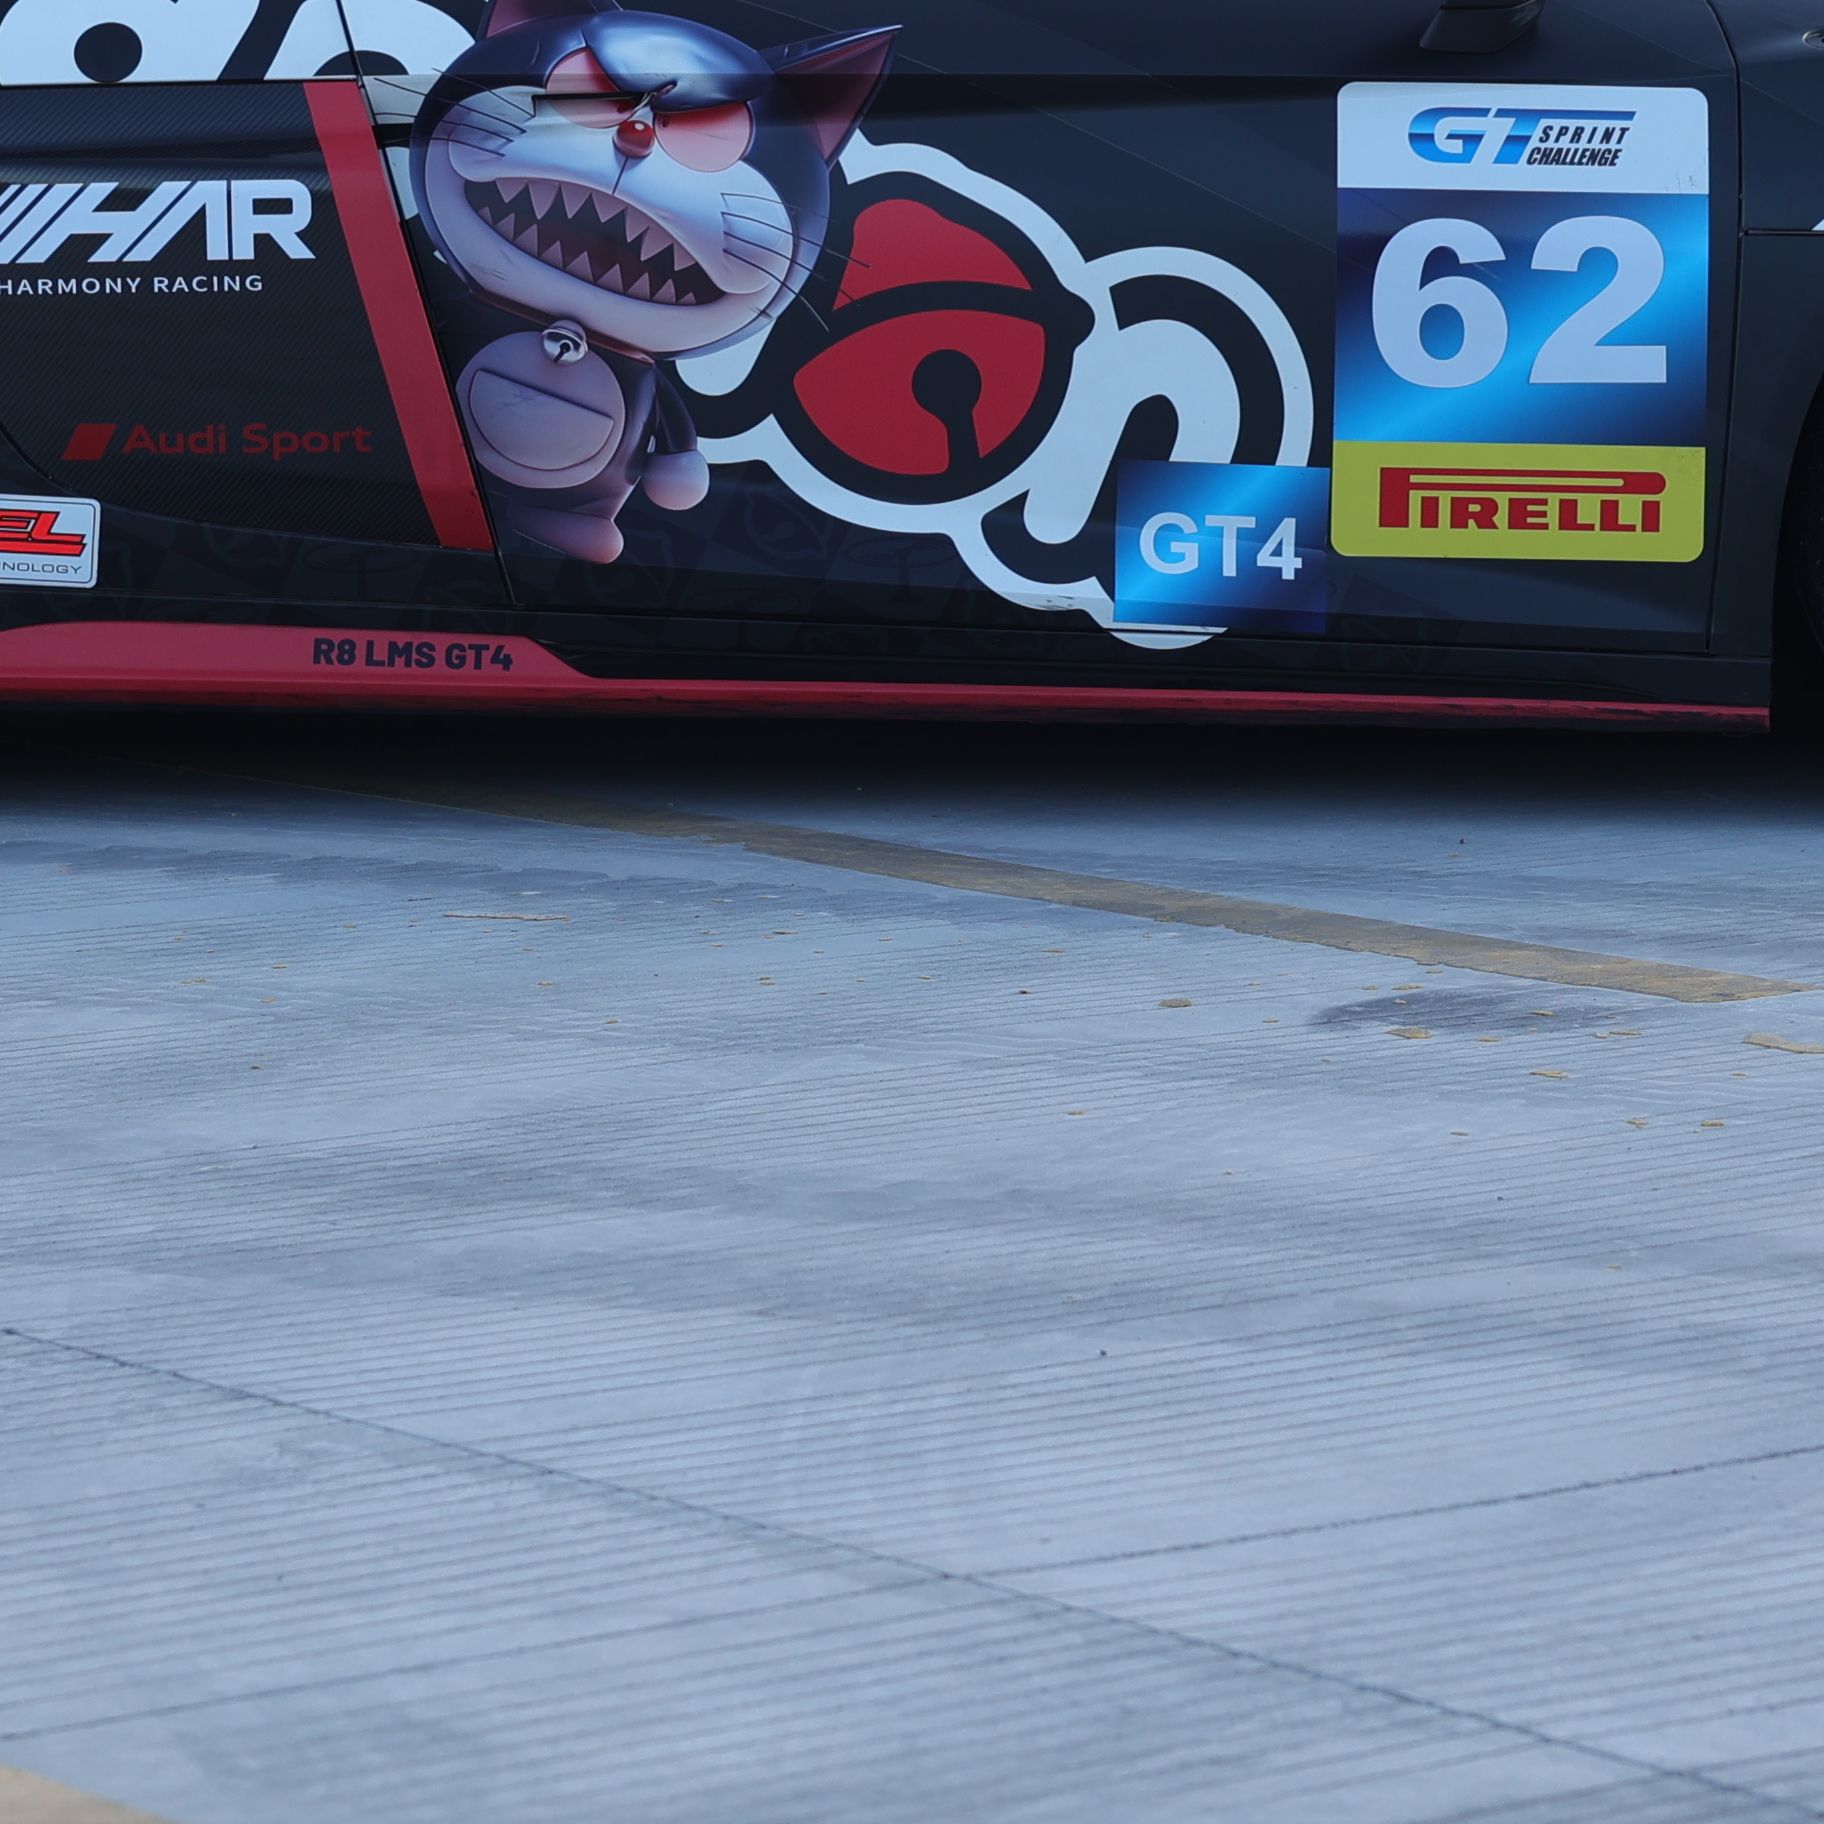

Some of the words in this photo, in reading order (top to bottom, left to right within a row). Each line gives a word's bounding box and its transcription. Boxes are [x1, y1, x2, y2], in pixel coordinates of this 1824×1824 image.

[1407, 106, 1638, 165] GT
[1538, 125, 1630, 145] SPRINT
[1526, 146, 1622, 167] CHALLENGE
[153, 274, 263, 293] RACING
[1372, 215, 1667, 388] 62
[122, 424, 227, 454] Audi
[241, 422, 374, 462] Sport
[1378, 465, 1667, 534] PIRELLI
[1139, 511, 1303, 581] GT4
[312, 637, 357, 666] R8
[365, 639, 436, 669] LMS
[444, 642, 514, 672] GT4
